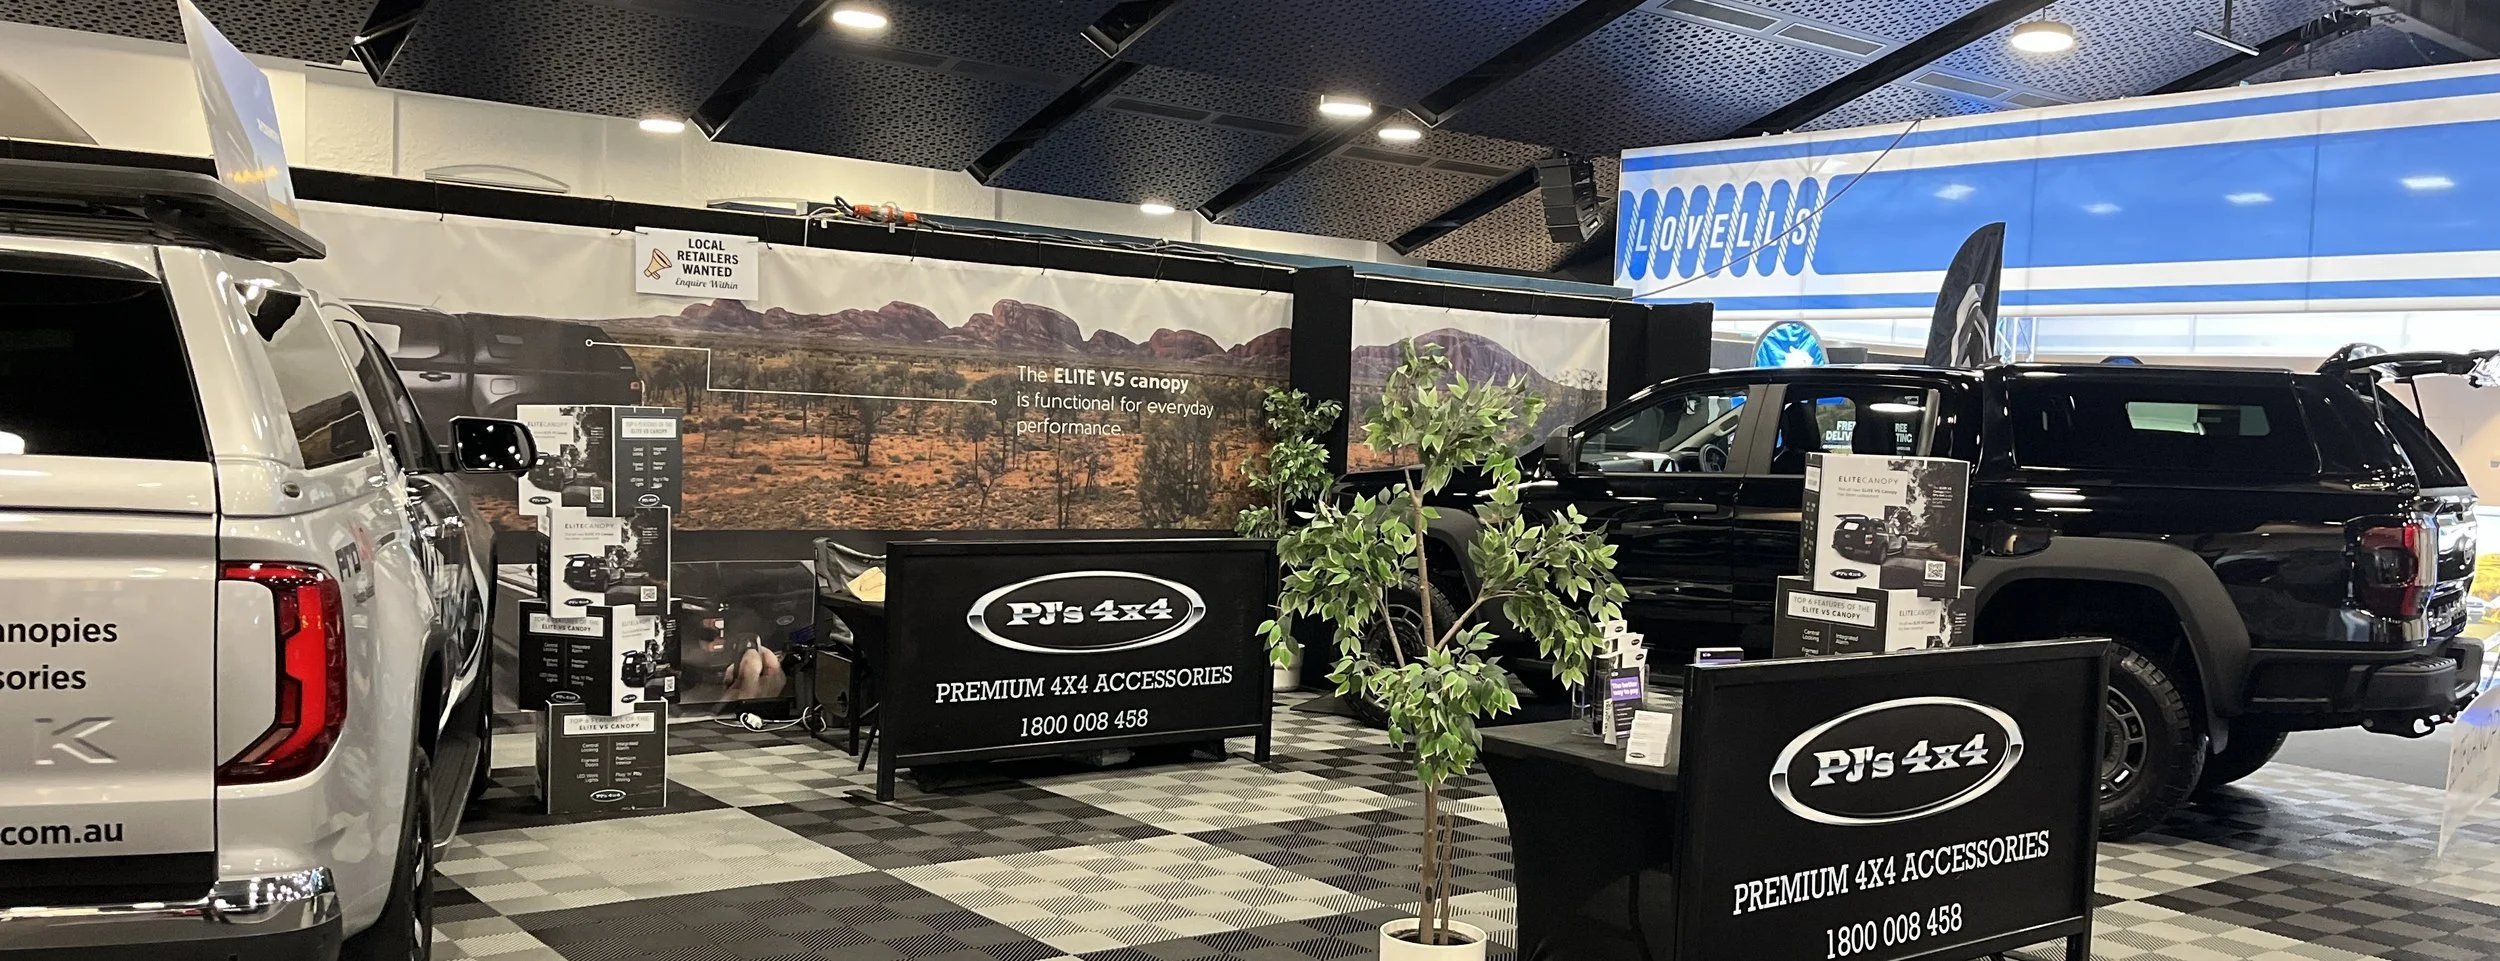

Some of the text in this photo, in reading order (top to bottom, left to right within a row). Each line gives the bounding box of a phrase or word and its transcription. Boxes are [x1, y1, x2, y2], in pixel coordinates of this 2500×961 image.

[688, 238, 726, 250] LOCAL
[1635, 208, 1811, 252] LOVELLS
[677, 250, 739, 265] RETAILERS
[682, 264, 732, 277] WANTED
[675, 278, 738, 289] Enquire Within
[1017, 365, 1189, 394] The ELITE V5 canopy
[1017, 391, 1214, 419] is functional for everyday
[1016, 419, 1125, 436] performance.
[1006, 598, 1173, 626] PJ's 4x4
[1802, 606, 1819, 614] ELITE
[1832, 610, 1860, 619] CANOPY
[935, 665, 1233, 703] PREMIUM 4X4 ACCESSORIES
[1020, 708, 1149, 737] 1800 008 458
[1810, 733, 1988, 787] PJ's 4x4
[0, 823, 123, 846] com.au
[1733, 830, 2050, 915] PREMIUM 4X4 ACCESSORIES
[1826, 903, 1963, 960] 1800 008 458
